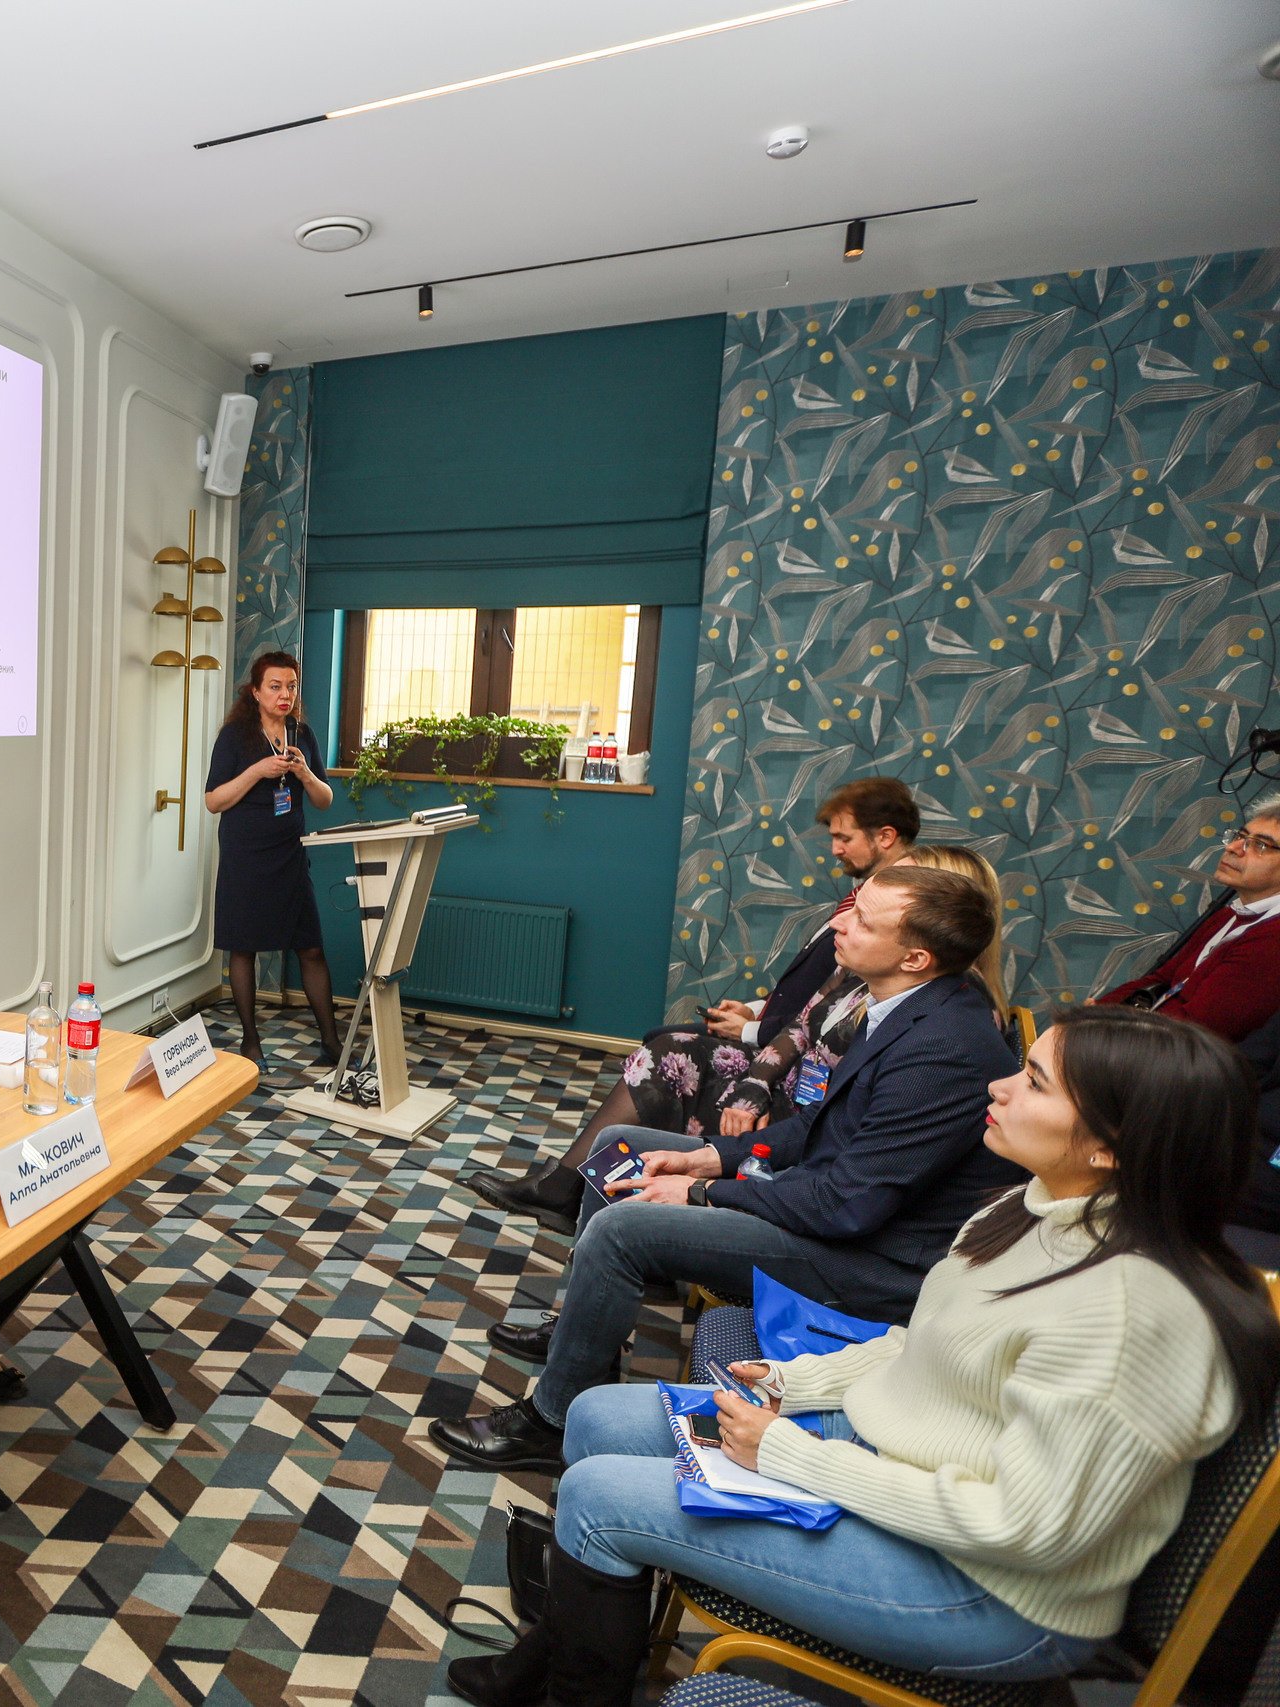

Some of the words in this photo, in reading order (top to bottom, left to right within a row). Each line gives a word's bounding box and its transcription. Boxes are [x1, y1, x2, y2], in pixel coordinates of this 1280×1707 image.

[163, 1032, 200, 1063] ГОРБУНОВА
[164, 1060, 181, 1079] Вера
[181, 1045, 207, 1072] Андреевна
[9, 1182, 38, 1205] Алла
[39, 1145, 101, 1188] Анатольевна
[17, 1132, 85, 1179] МАКОВИЧ
